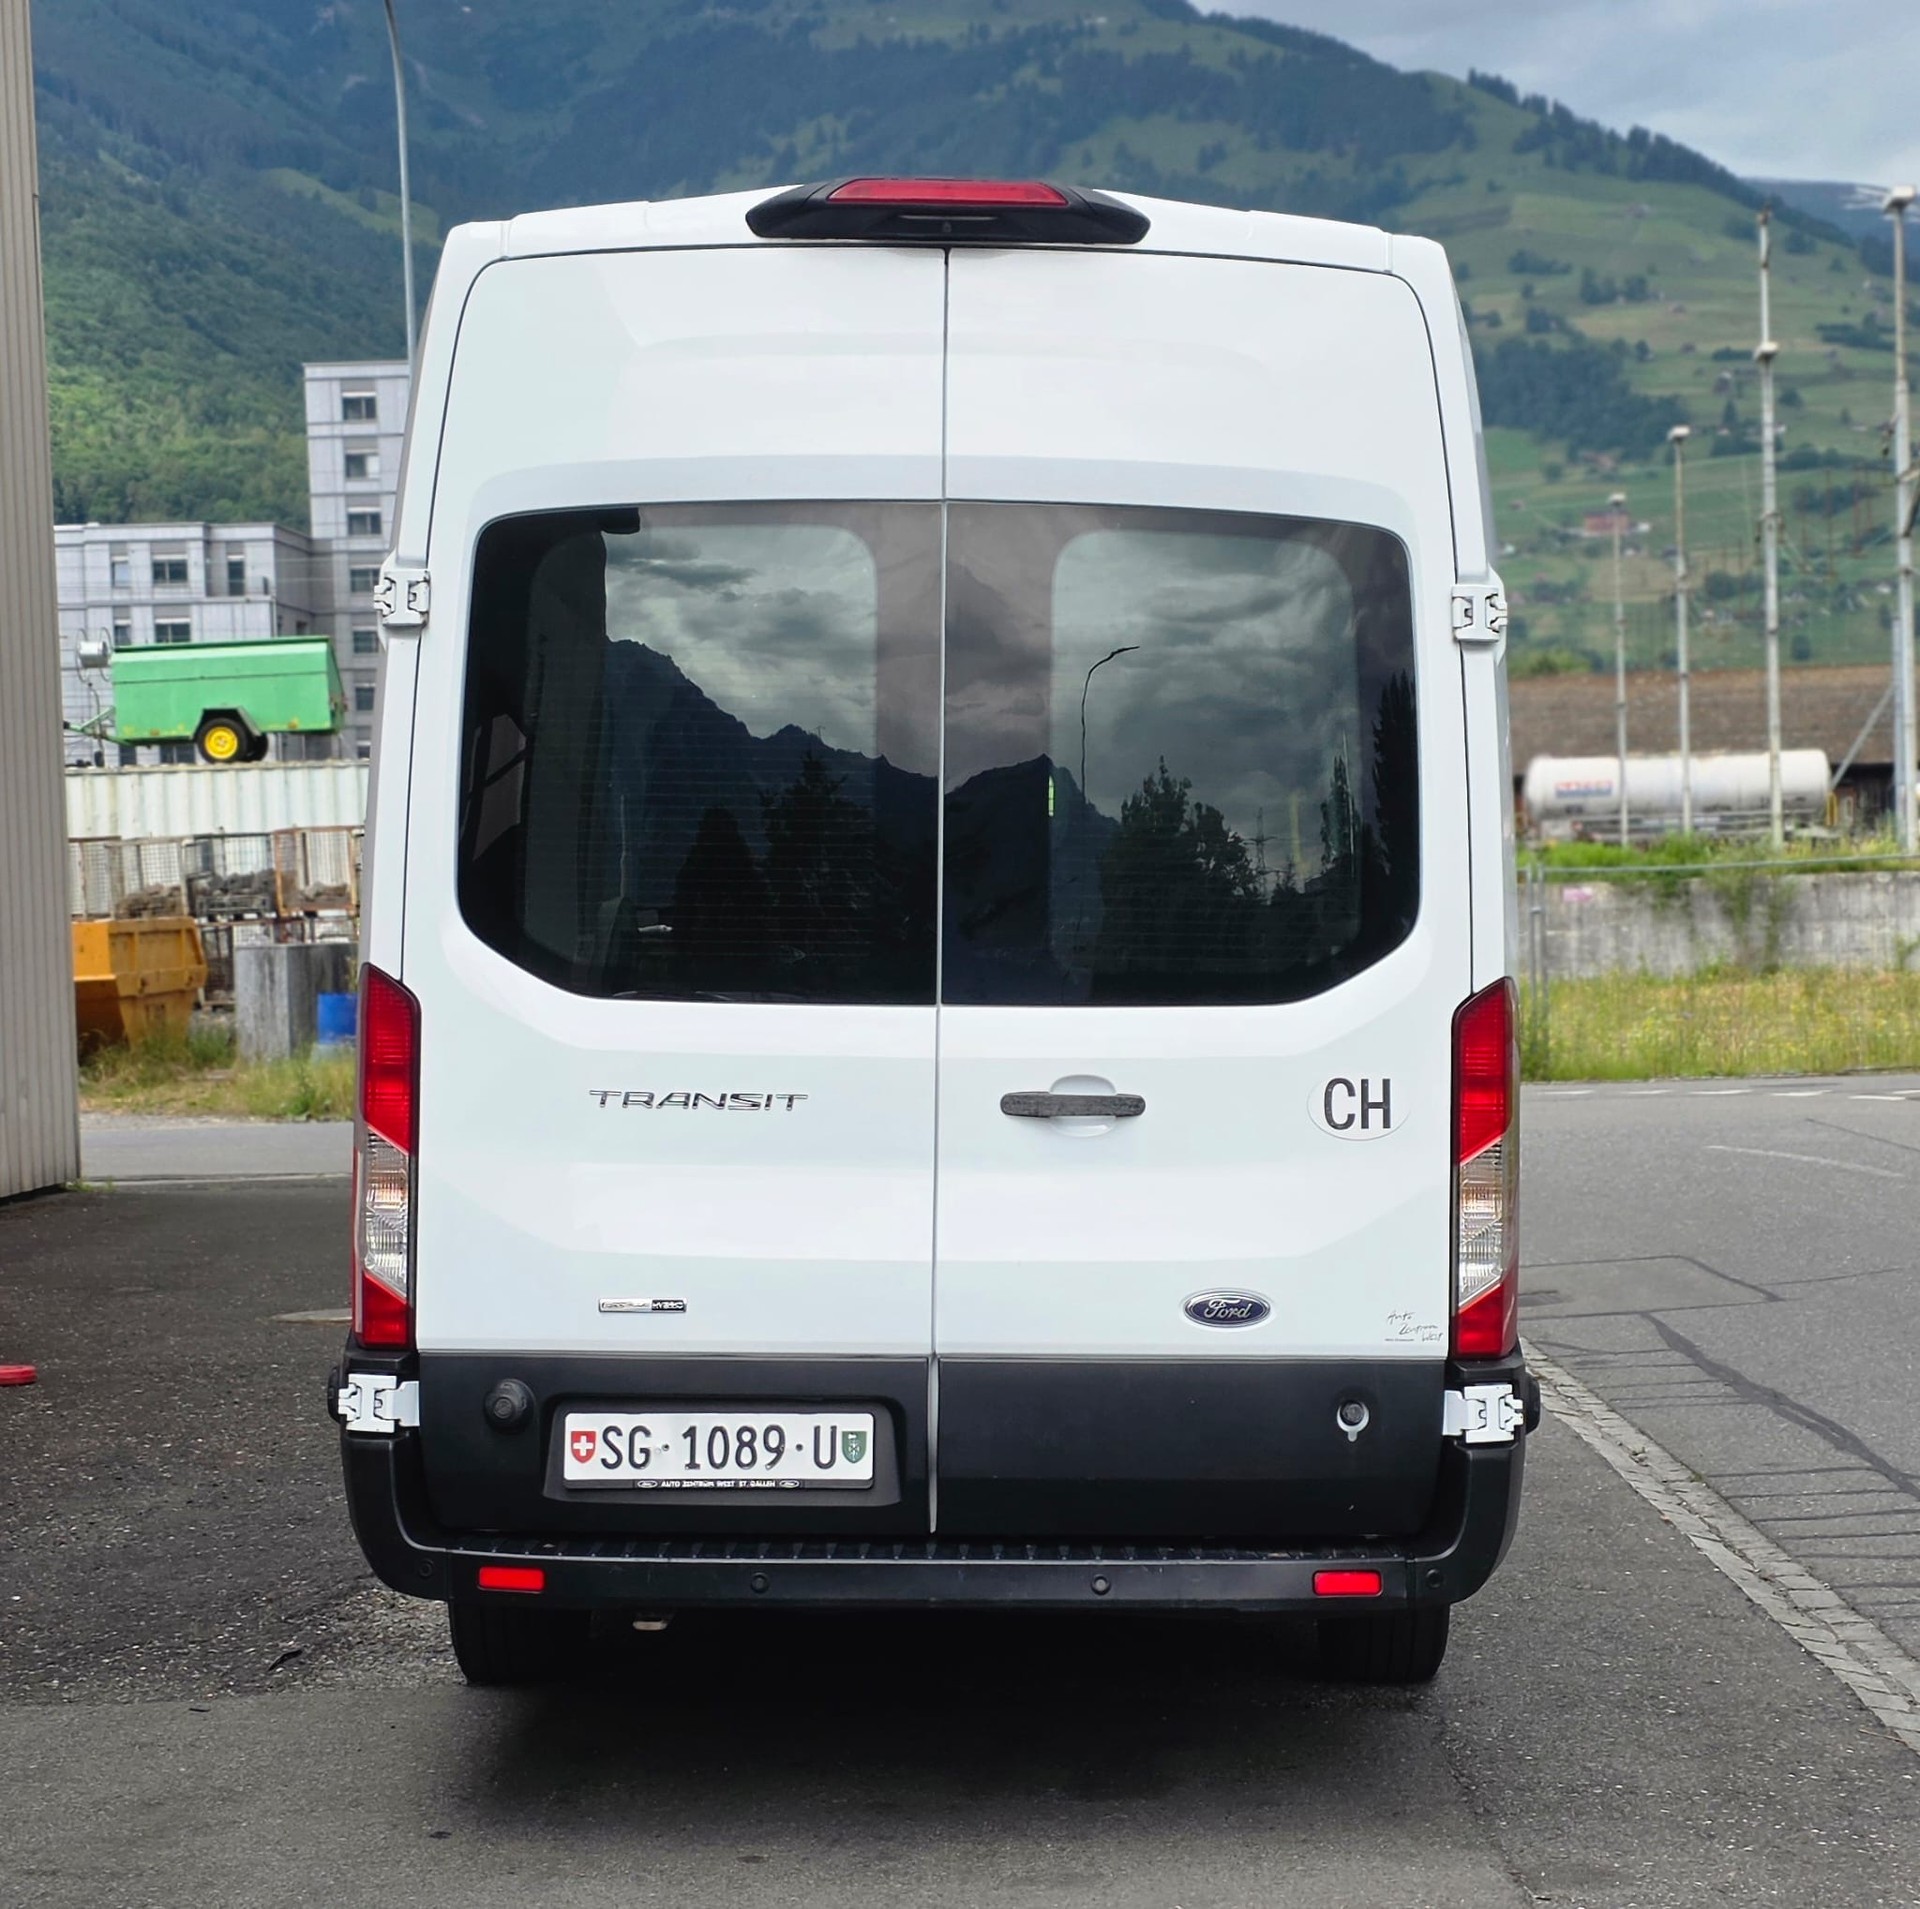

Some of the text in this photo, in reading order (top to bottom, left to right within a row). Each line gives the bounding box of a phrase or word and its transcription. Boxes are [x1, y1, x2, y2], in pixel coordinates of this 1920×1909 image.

[589, 1089, 809, 1112] TRANSIT
[1323, 1077, 1391, 1130] CH
[1203, 1298, 1252, 1319] Ford
[682, 1425, 786, 1470] 1089
[660, 1480, 681, 1488] AUTO
